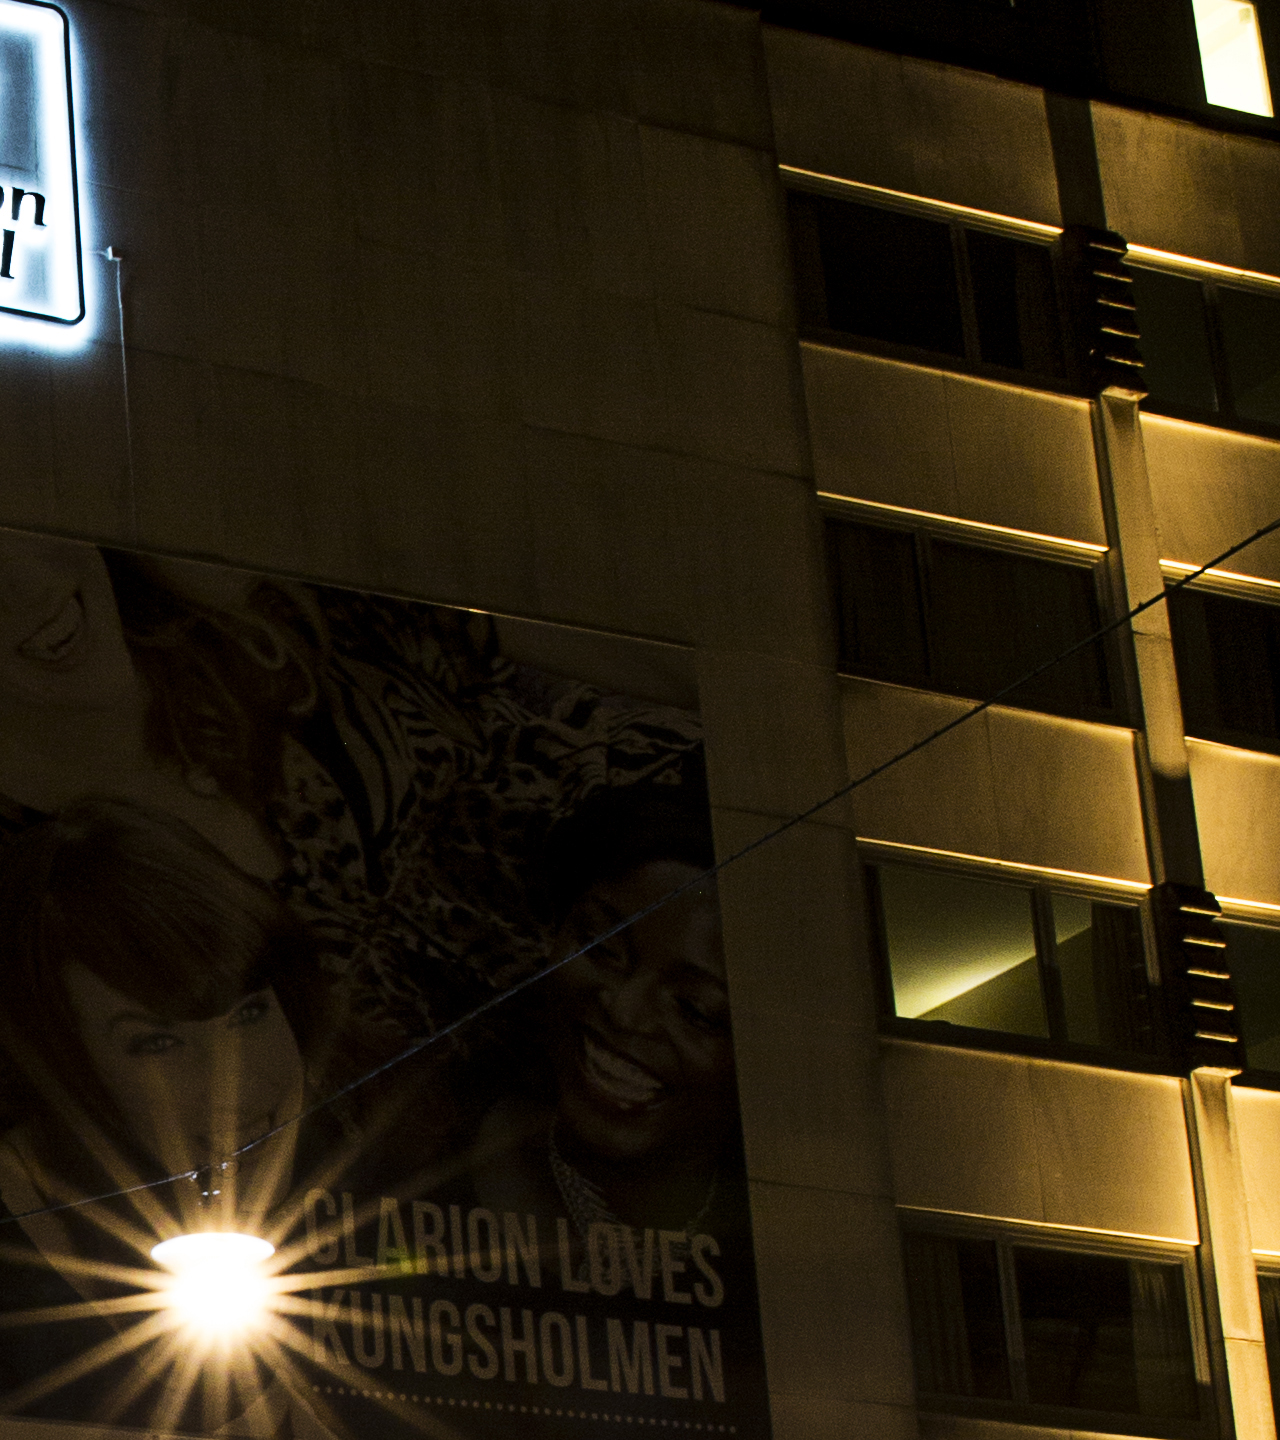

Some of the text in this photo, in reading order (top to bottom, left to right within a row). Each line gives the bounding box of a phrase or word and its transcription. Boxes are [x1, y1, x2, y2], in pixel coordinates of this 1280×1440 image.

[303, 1187, 726, 1309] CLARION LOVES
[311, 1289, 726, 1404] KUNGSHOLMEN
